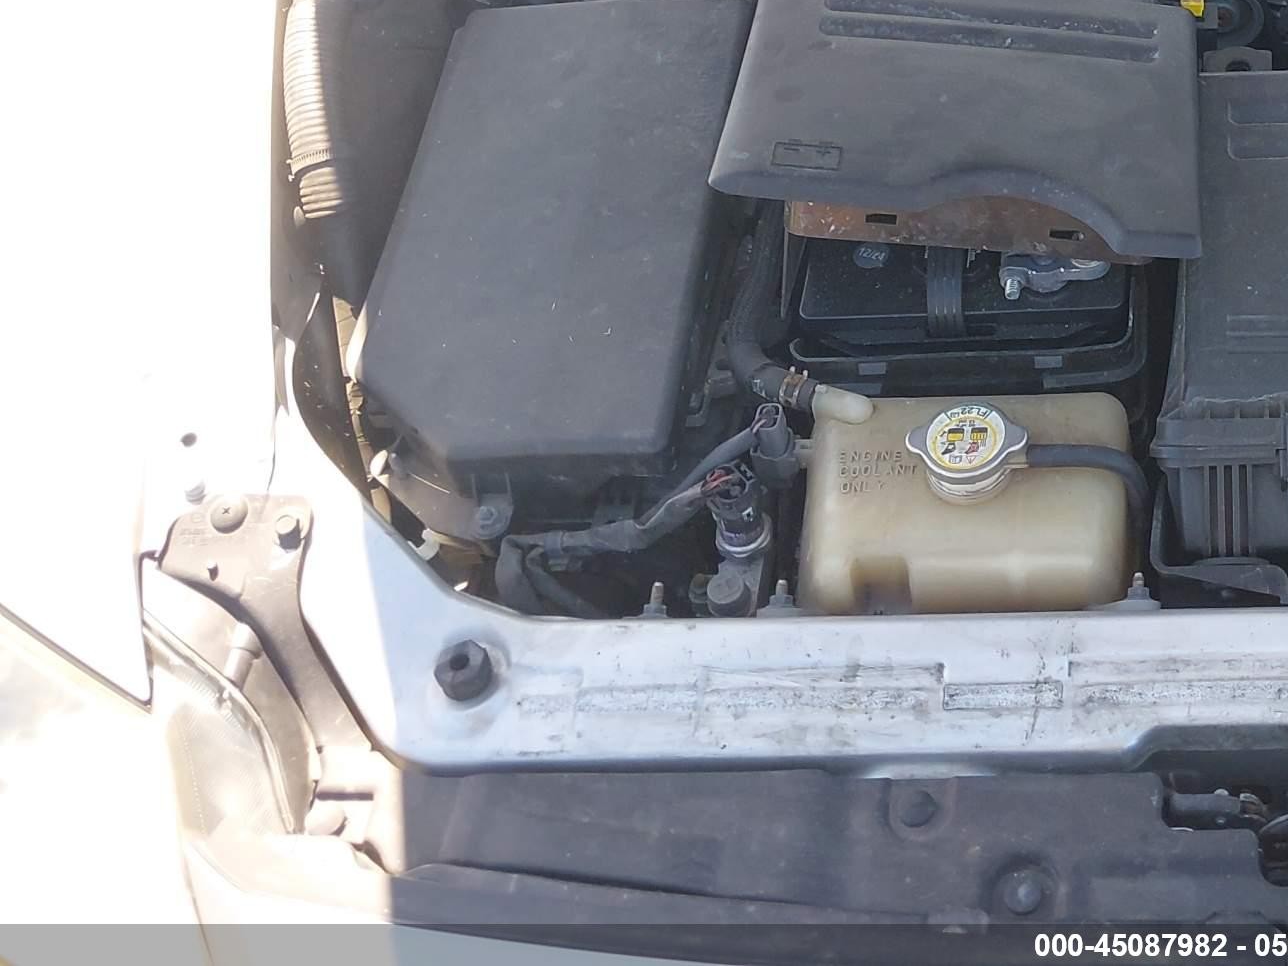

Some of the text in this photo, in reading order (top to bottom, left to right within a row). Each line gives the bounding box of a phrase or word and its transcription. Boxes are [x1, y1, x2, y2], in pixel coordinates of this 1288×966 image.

[840, 450, 903, 464] ENGINE
[840, 464, 918, 478] COOLANT
[840, 480, 887, 494] ONLY
